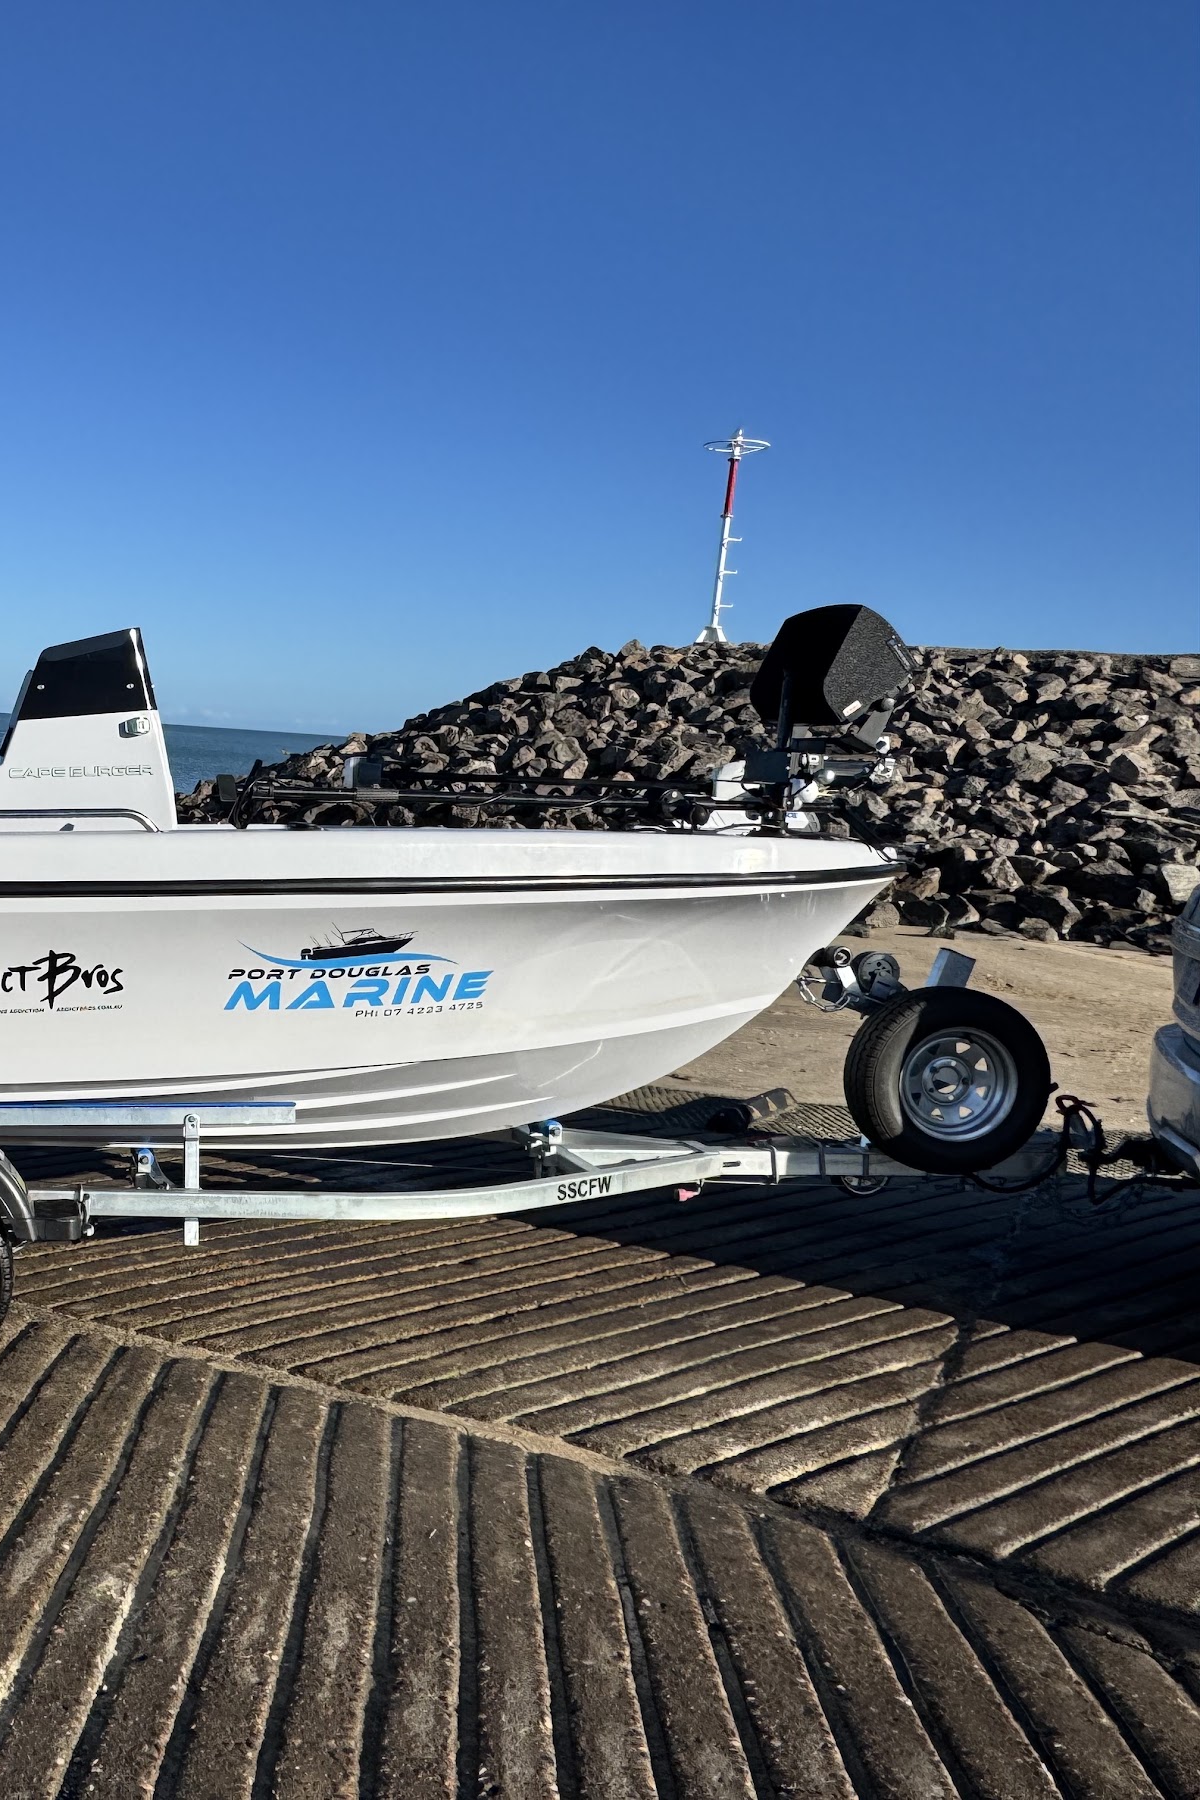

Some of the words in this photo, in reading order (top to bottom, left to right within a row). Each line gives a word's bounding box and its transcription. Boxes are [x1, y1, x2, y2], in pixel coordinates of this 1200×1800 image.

[8, 766, 66, 779] CAPE
[69, 764, 154, 778] BURGER
[32, 949, 124, 1010] Bros
[228, 968, 303, 980] PORT
[310, 963, 432, 980] DOUGLAS
[223, 970, 494, 1011] MARINE
[383, 1008, 402, 1017] 07
[406, 1005, 443, 1015] 4223
[448, 1001, 483, 1011] 4725
[557, 1175, 612, 1201] SSCFW
